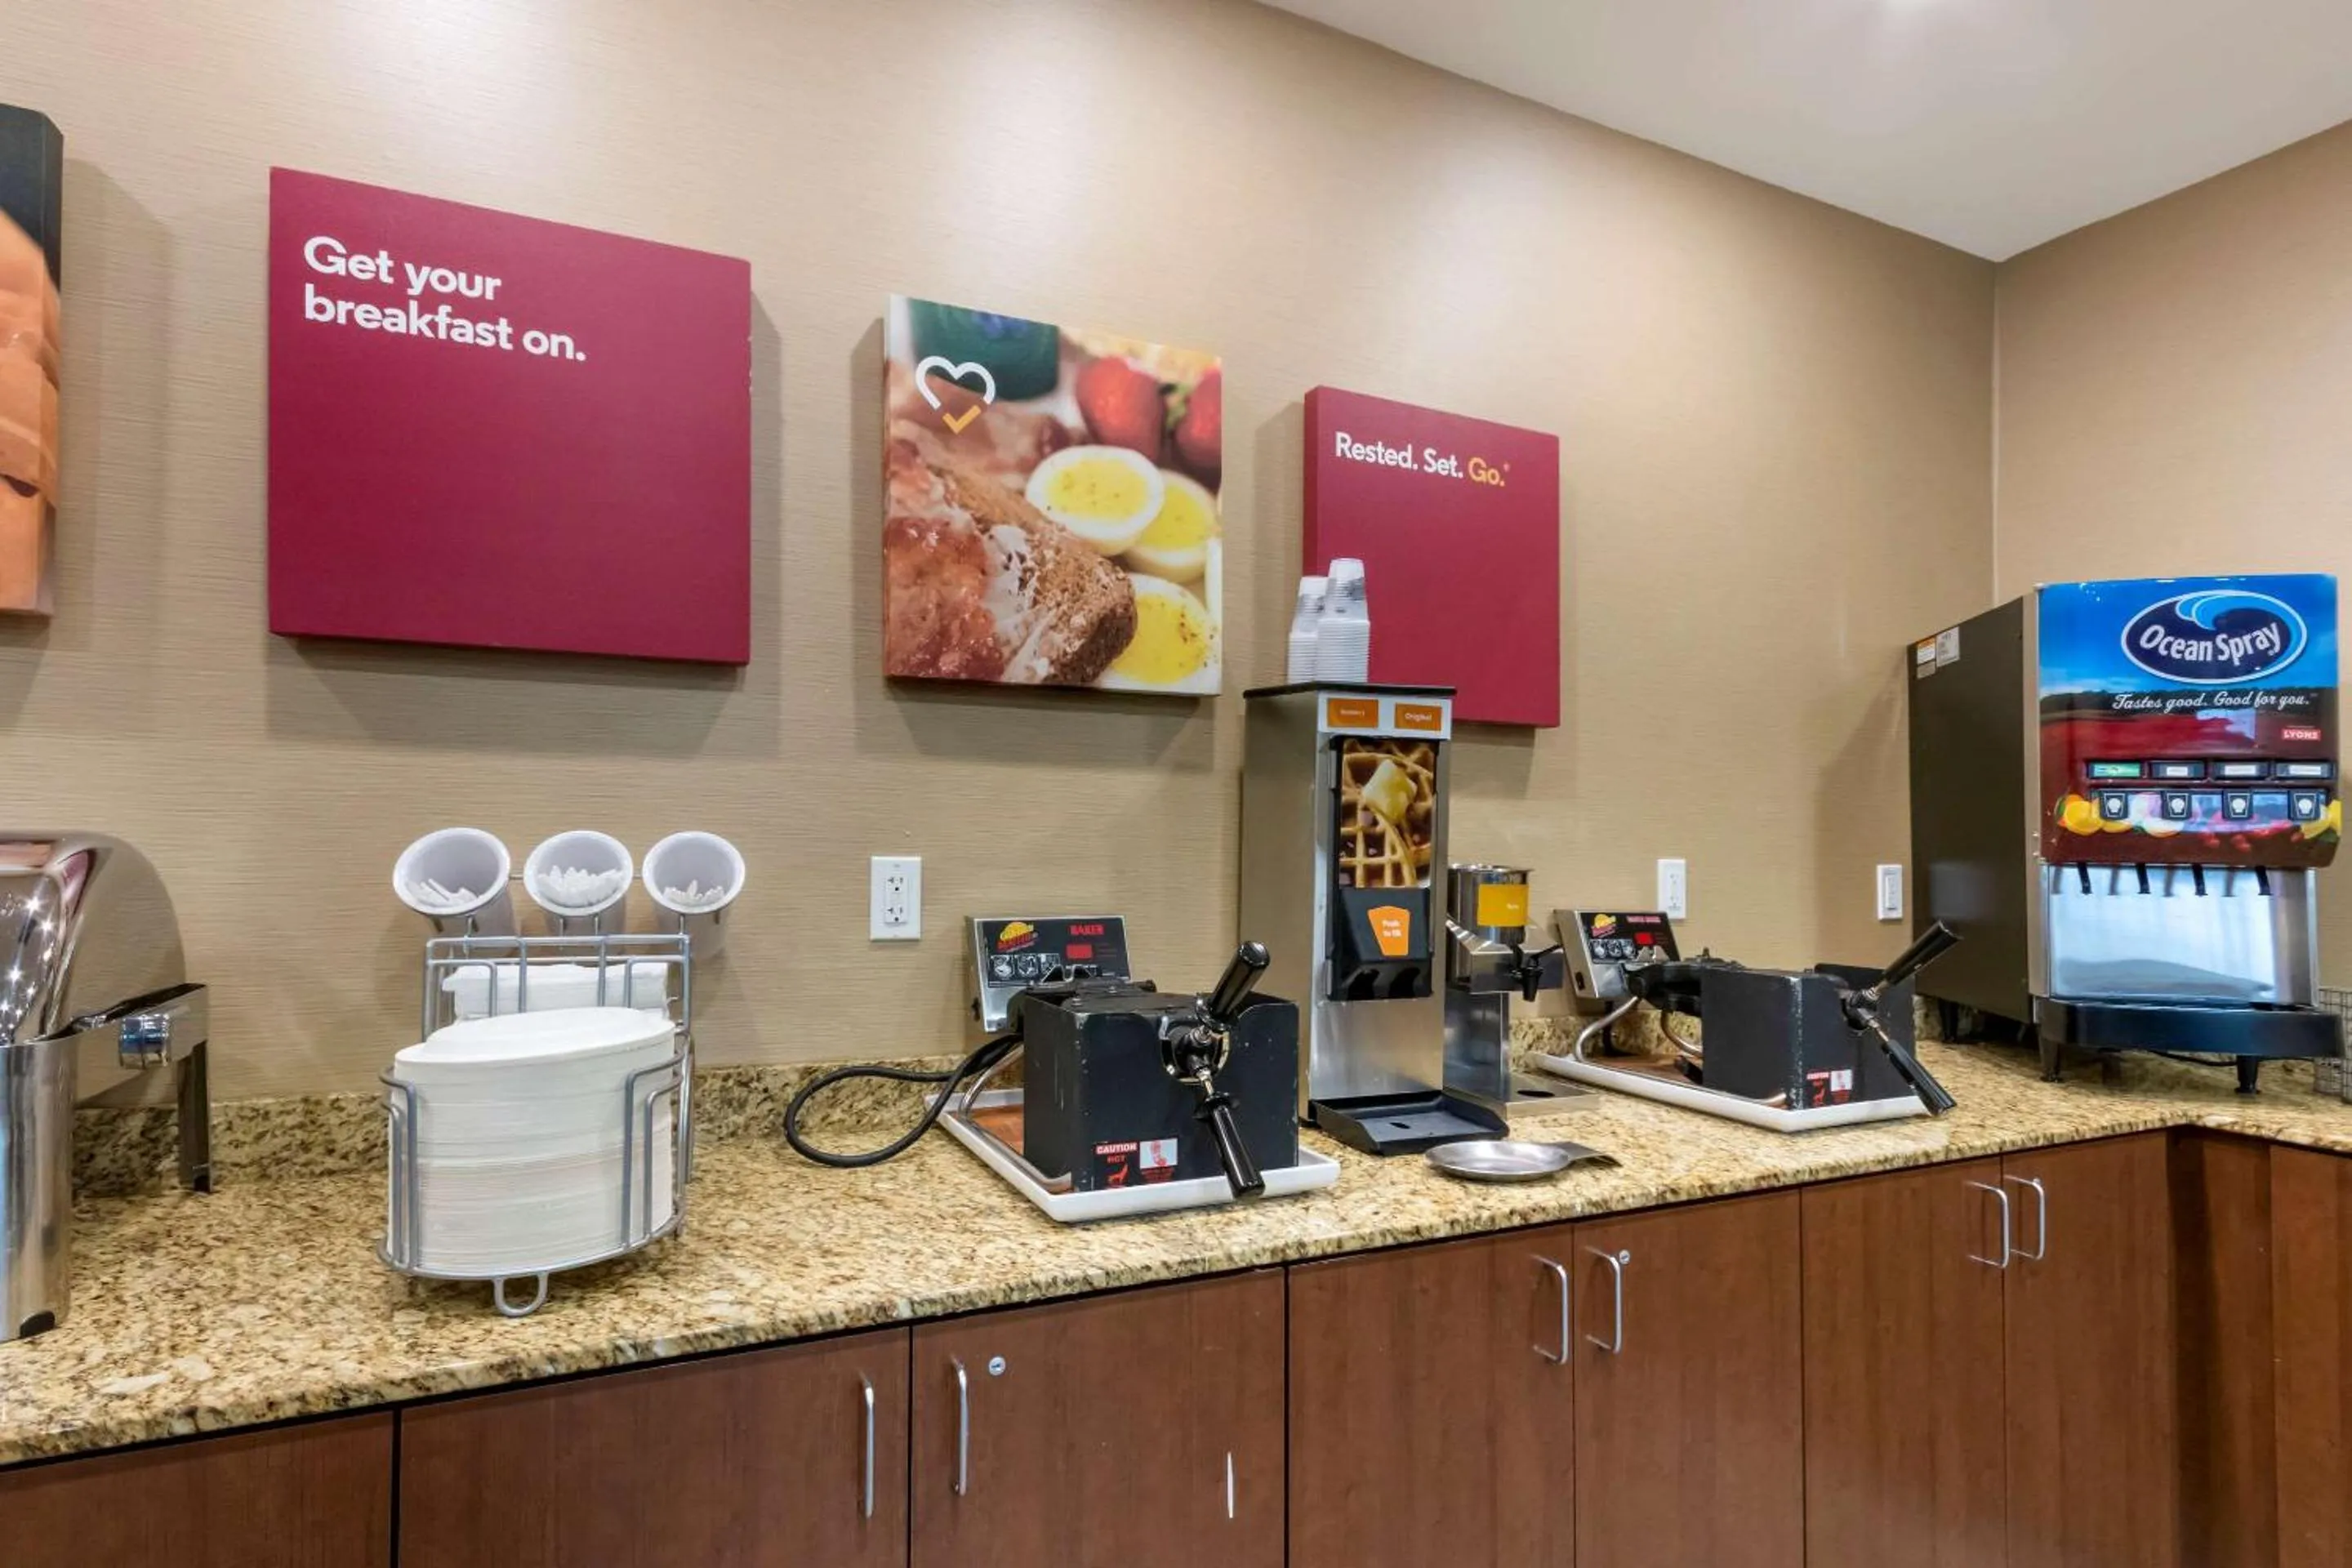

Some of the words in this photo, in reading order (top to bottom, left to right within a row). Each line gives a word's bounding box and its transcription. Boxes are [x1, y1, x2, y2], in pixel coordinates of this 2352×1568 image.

[304, 235, 394, 283] Get
[403, 262, 501, 300] your
[305, 283, 513, 350] breakfast
[523, 330, 586, 361] on.
[1335, 431, 1419, 470] Rested.
[1423, 448, 1463, 478] Set.
[2140, 624, 2213, 662] Ocean
[2216, 622, 2281, 665] Spray
[2112, 694, 2163, 709] Tastes
[2164, 693, 2207, 713] good.
[2212, 691, 2252, 706] Good
[2253, 692, 2276, 707] for
[2277, 694, 2310, 710] you.
[1097, 1143, 1137, 1154] CAUTION
